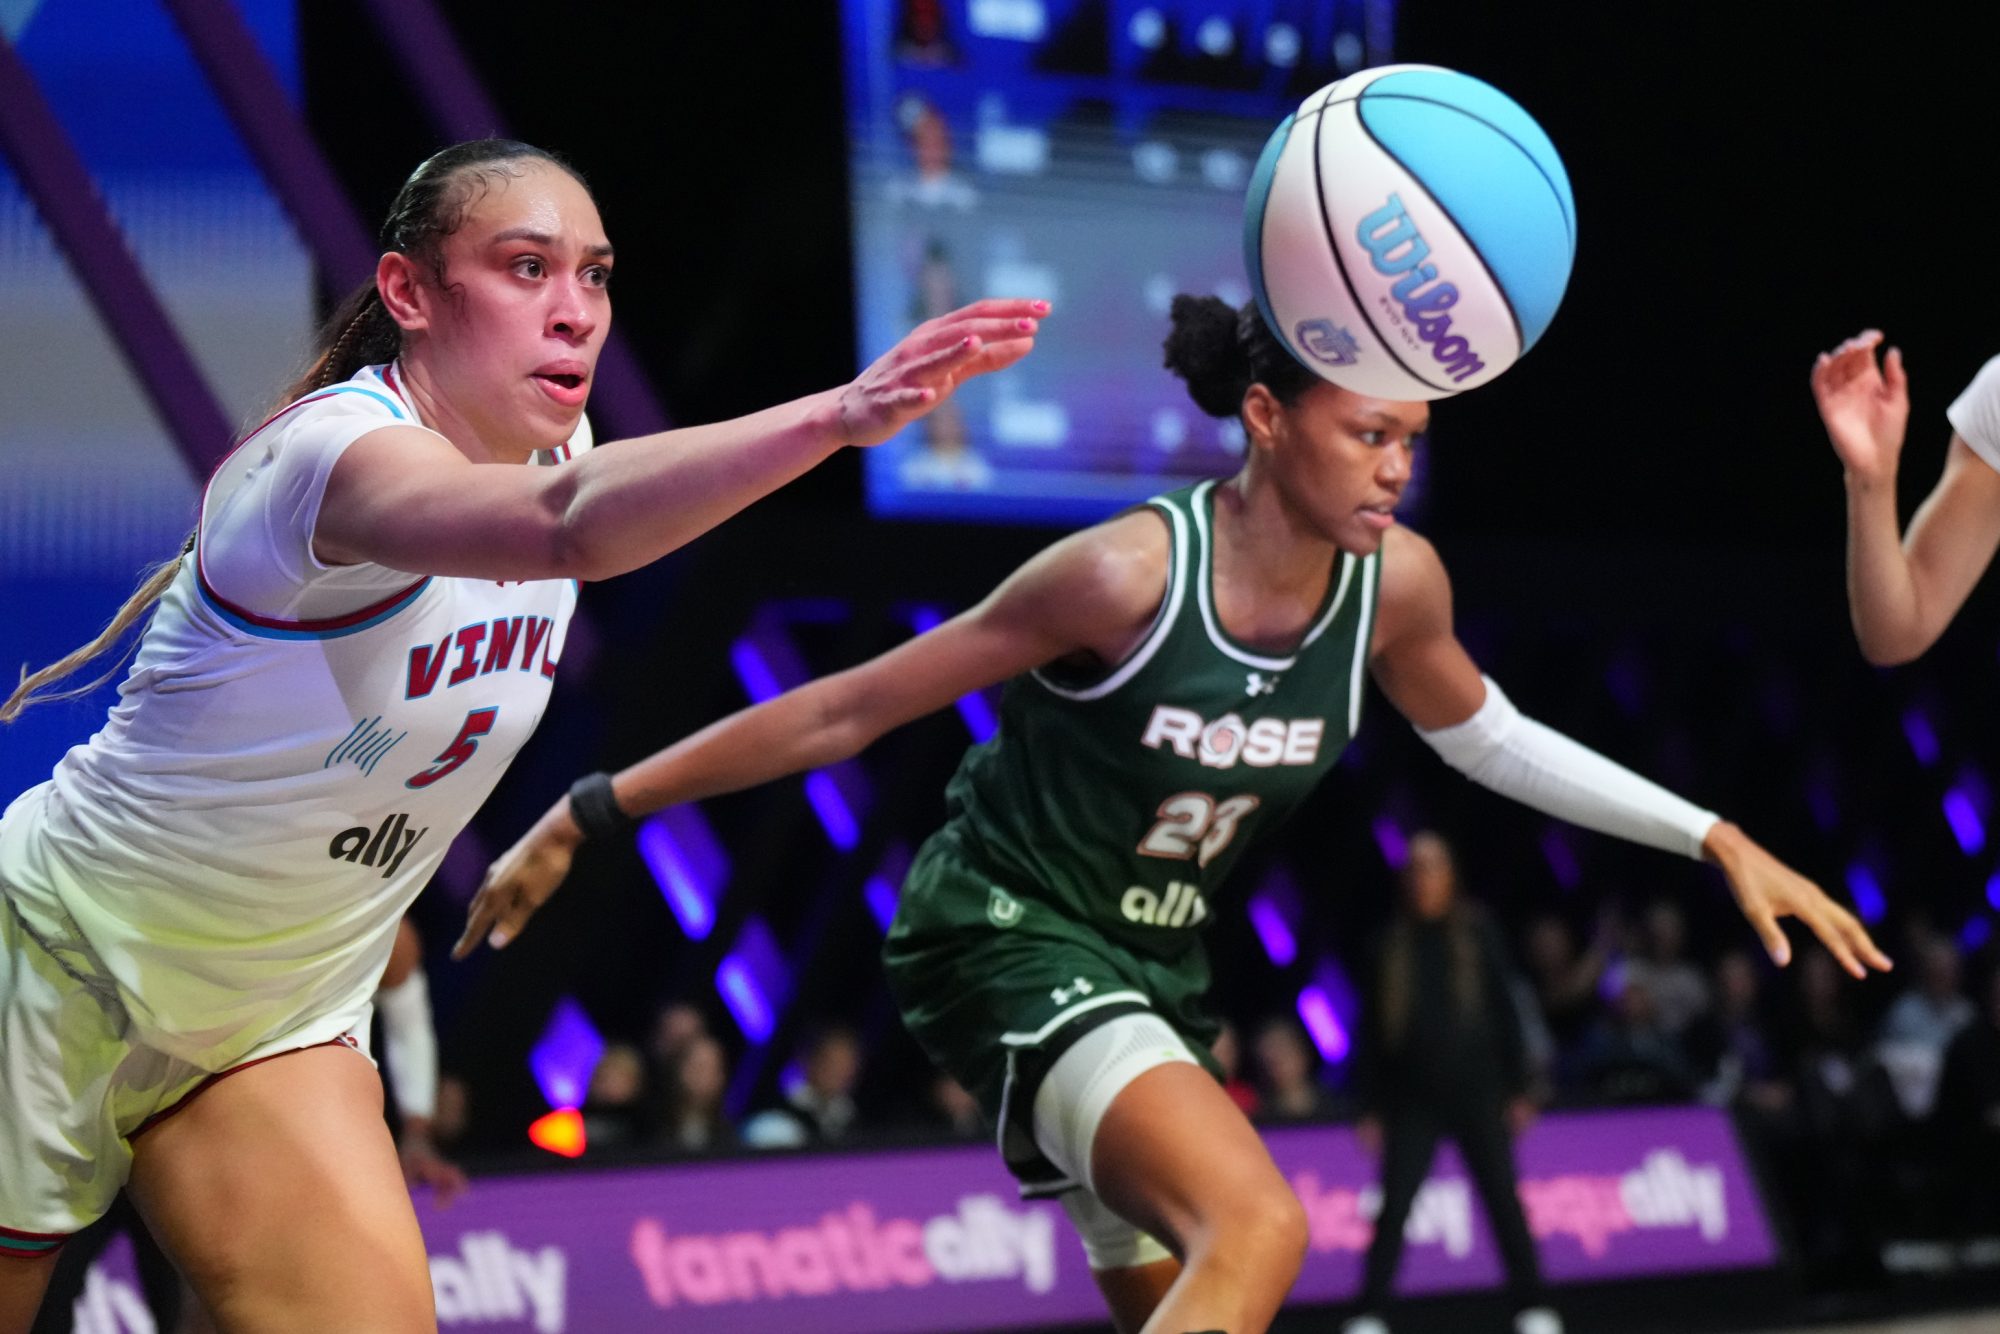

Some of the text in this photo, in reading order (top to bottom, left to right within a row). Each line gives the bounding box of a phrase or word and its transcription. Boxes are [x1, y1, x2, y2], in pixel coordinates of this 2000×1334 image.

[1356, 191, 1485, 383] Wilson
[404, 705, 499, 789] 5
[1141, 704, 1325, 769] ROSE
[328, 813, 429, 879] ally
[1136, 791, 1261, 869] 23
[630, 1195, 1056, 1309] fanatically
